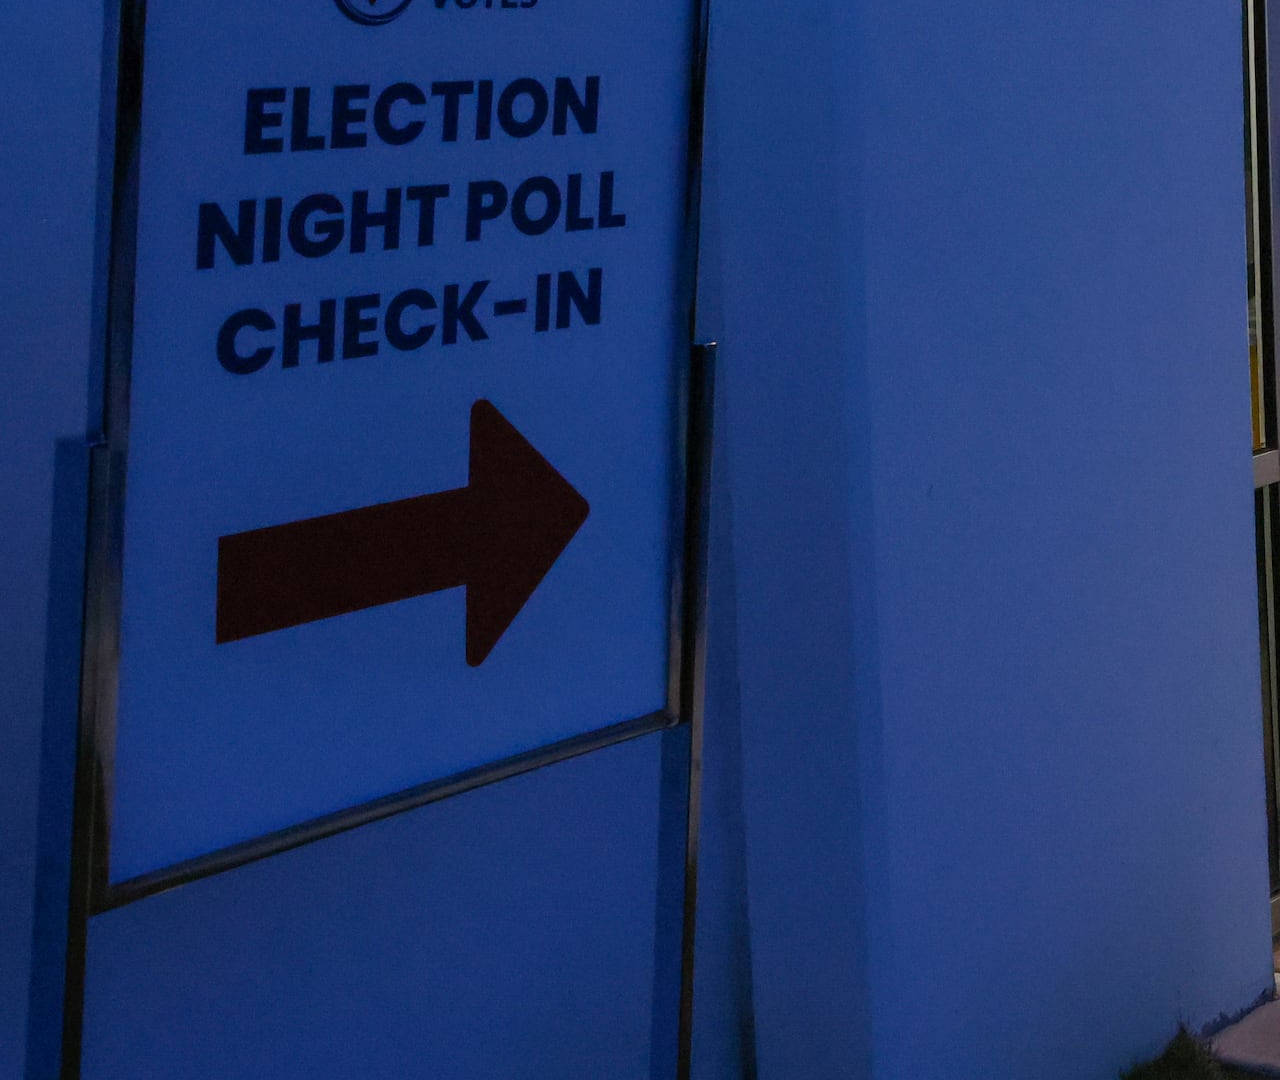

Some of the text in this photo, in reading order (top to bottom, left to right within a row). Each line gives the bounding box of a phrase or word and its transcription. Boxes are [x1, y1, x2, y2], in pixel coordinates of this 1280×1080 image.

[243, 75, 600, 156] ELECTION
[196, 171, 626, 271] NIGHT POLL
[215, 267, 602, 376] CHECK-IN
